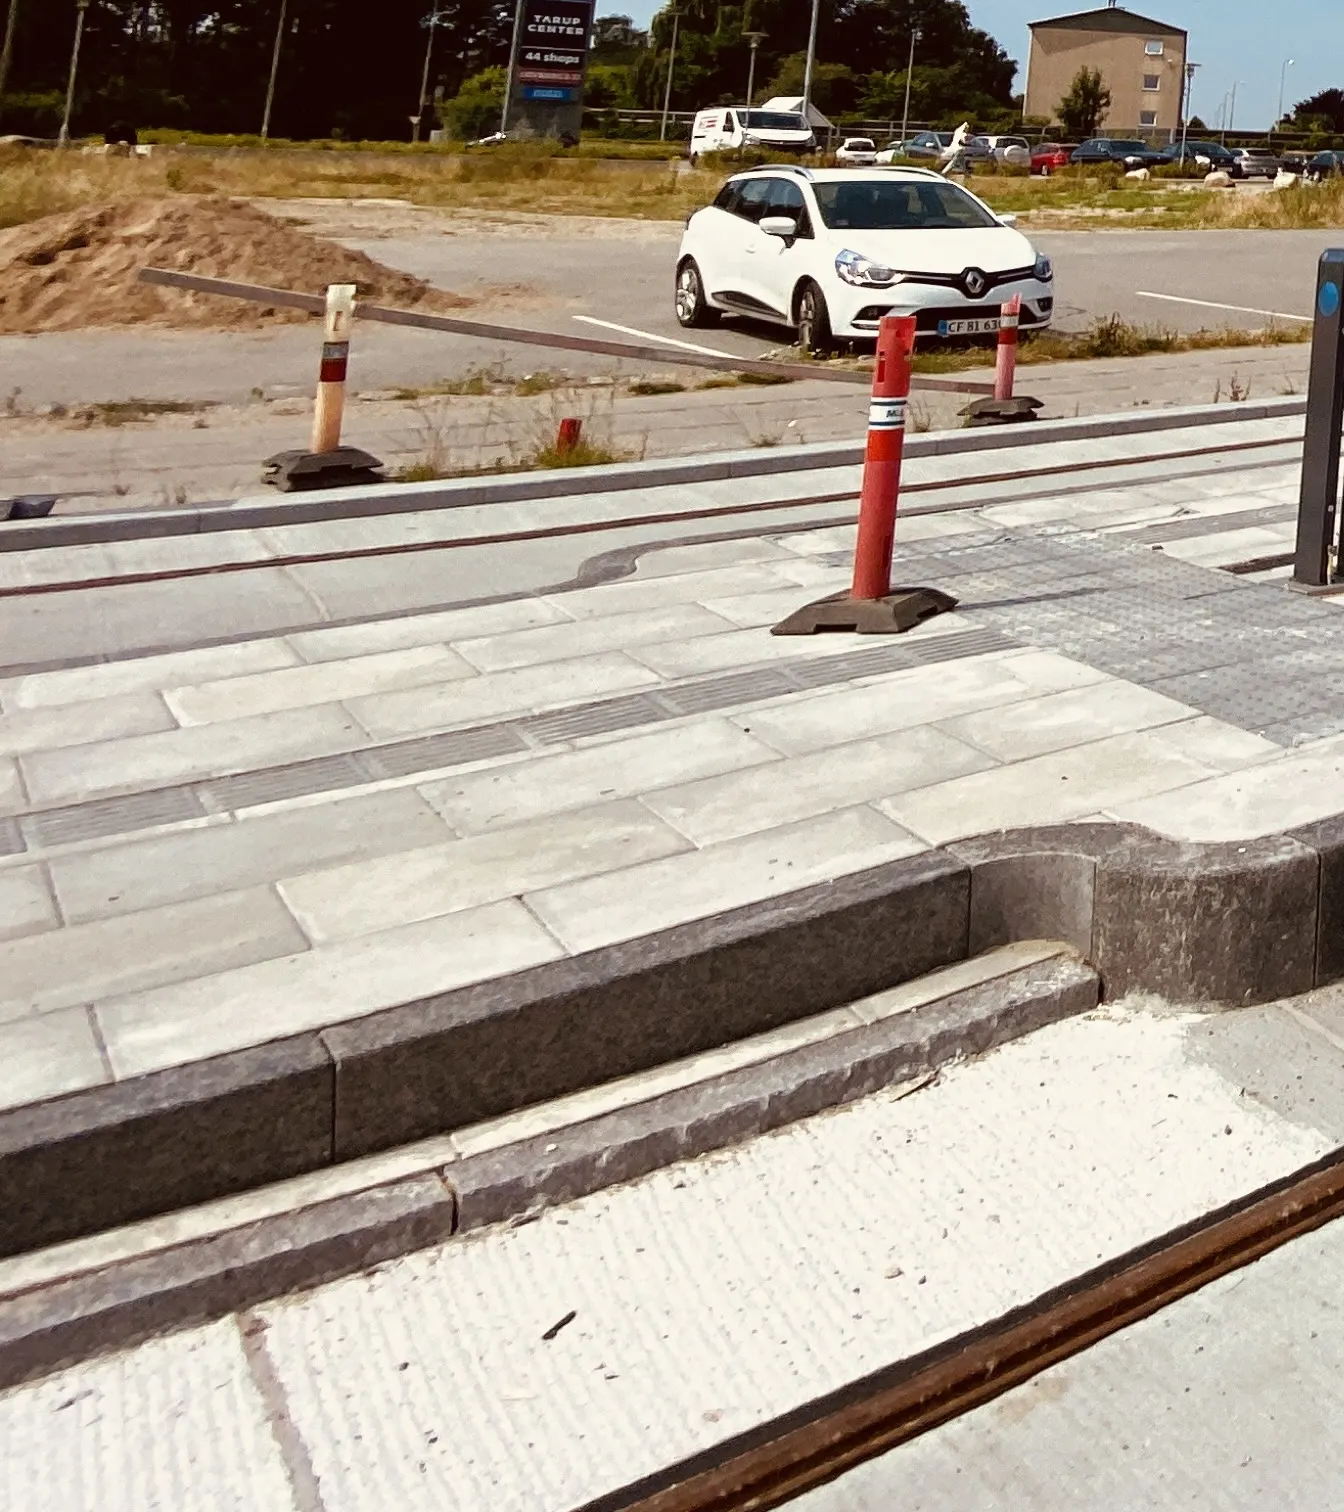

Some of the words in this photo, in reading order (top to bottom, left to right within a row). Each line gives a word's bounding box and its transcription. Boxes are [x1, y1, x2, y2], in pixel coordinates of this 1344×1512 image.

[533, 14, 581, 25] TARUP
[527, 24, 584, 35] CENTER
[525, 52, 541, 61] 44
[543, 52, 580, 64] shops
[948, 321, 965, 333] CF
[967, 320, 979, 332] 81
[983, 319, 1001, 331] 63
